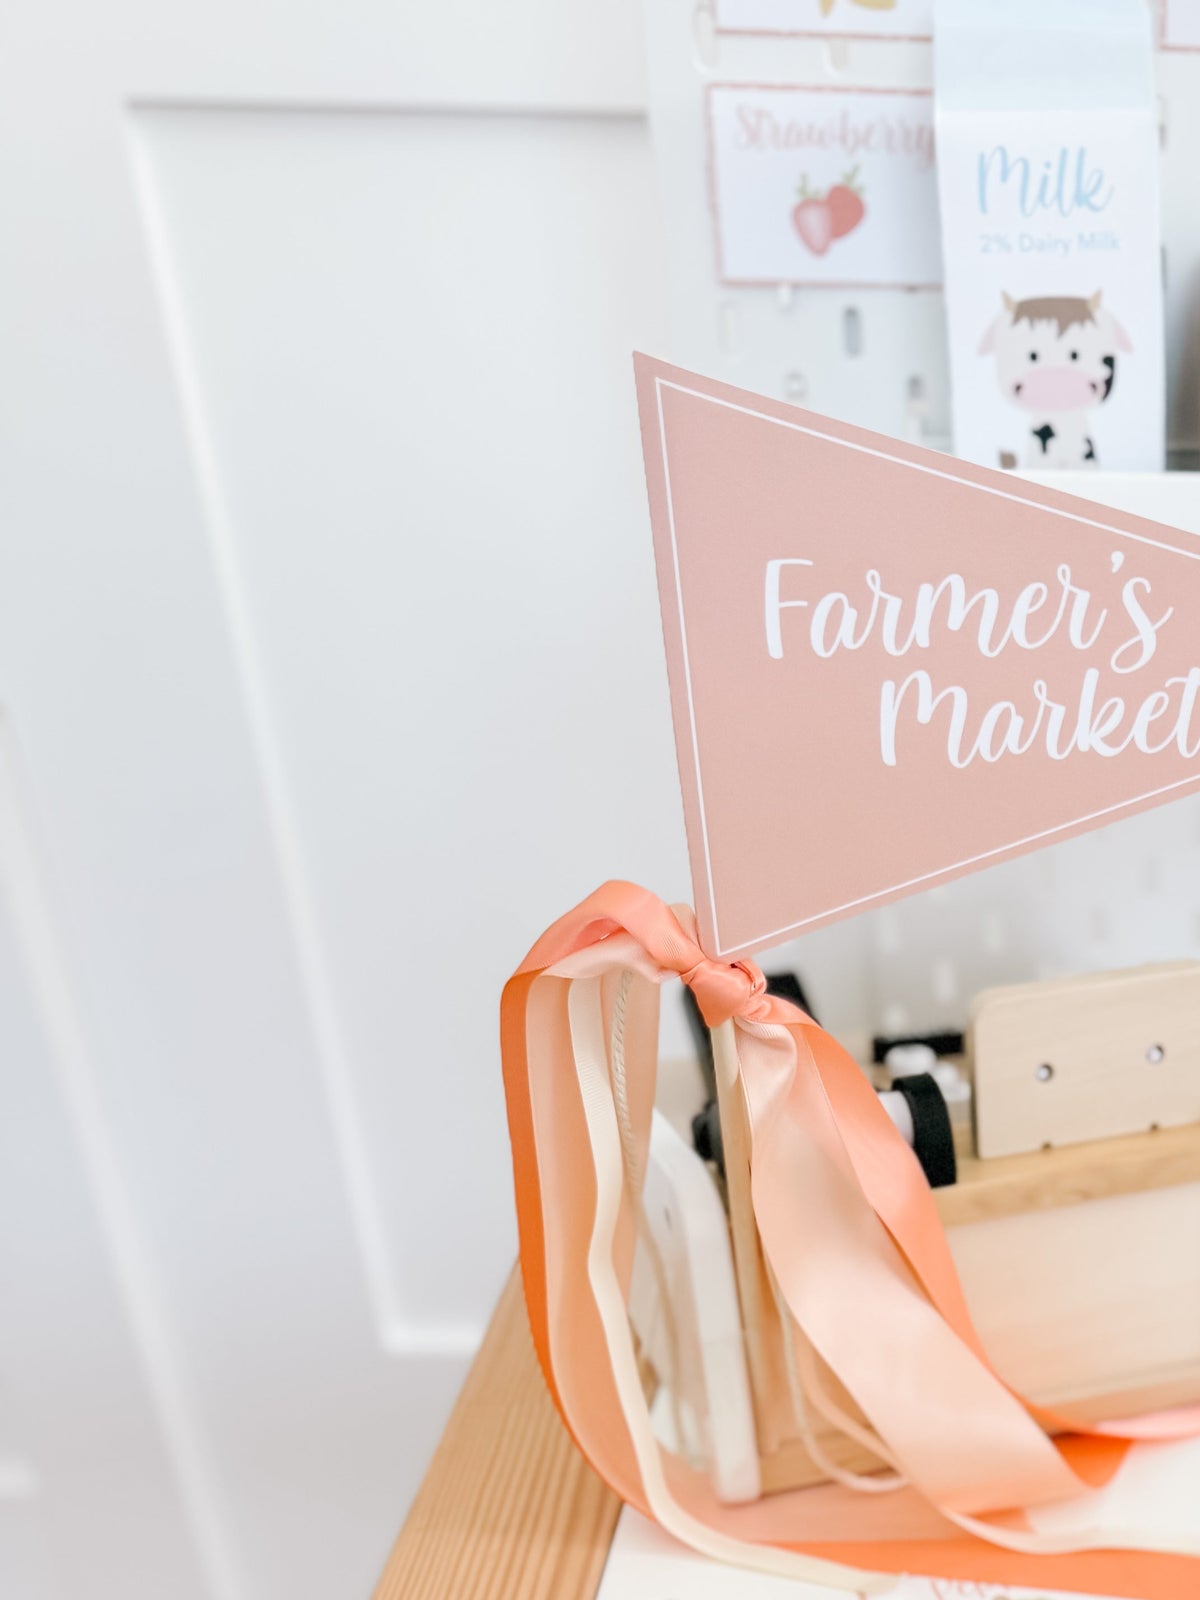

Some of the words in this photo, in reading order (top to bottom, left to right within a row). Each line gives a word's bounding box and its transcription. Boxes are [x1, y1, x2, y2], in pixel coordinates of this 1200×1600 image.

[977, 145, 1114, 217] Milk
[1019, 232, 1069, 256] Dairy
[1077, 232, 1119, 251] Milk
[764, 550, 1174, 674] Farmer's
